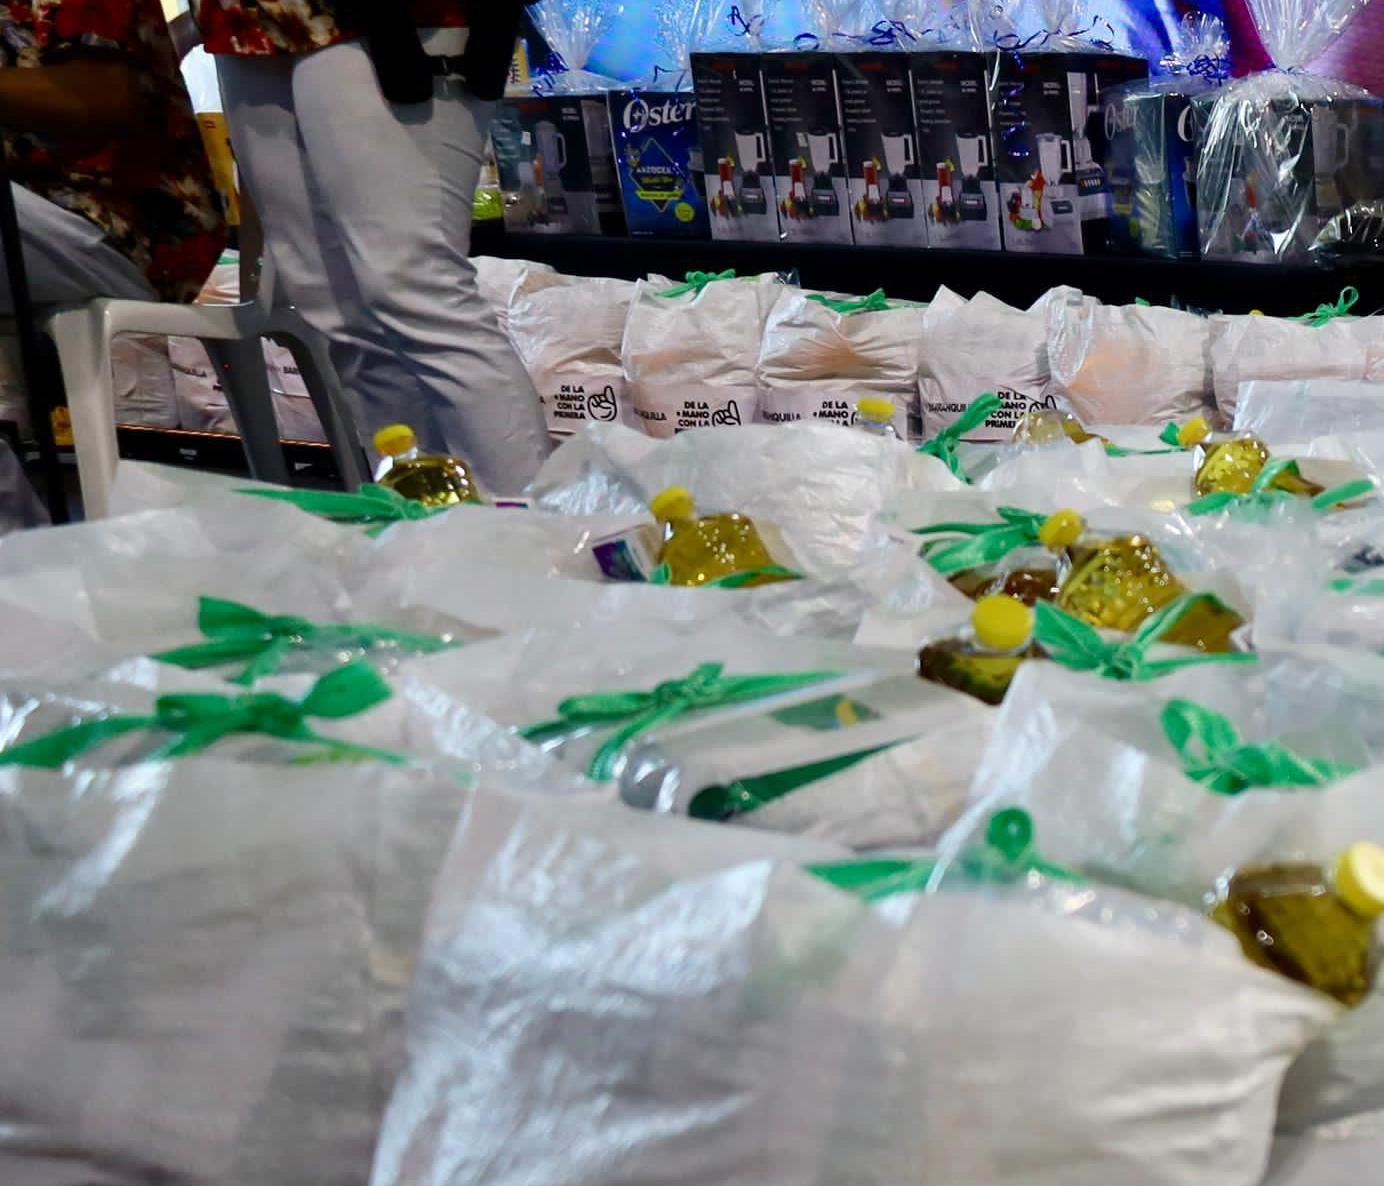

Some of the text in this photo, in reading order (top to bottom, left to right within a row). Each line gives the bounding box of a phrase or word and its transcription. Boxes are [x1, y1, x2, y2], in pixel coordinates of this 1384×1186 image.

[623, 98, 697, 133] Oster
[684, 402, 709, 410] DE LA
[822, 401, 833, 409] DE
[682, 411, 709, 419] MANO
[819, 411, 849, 419] MANO
